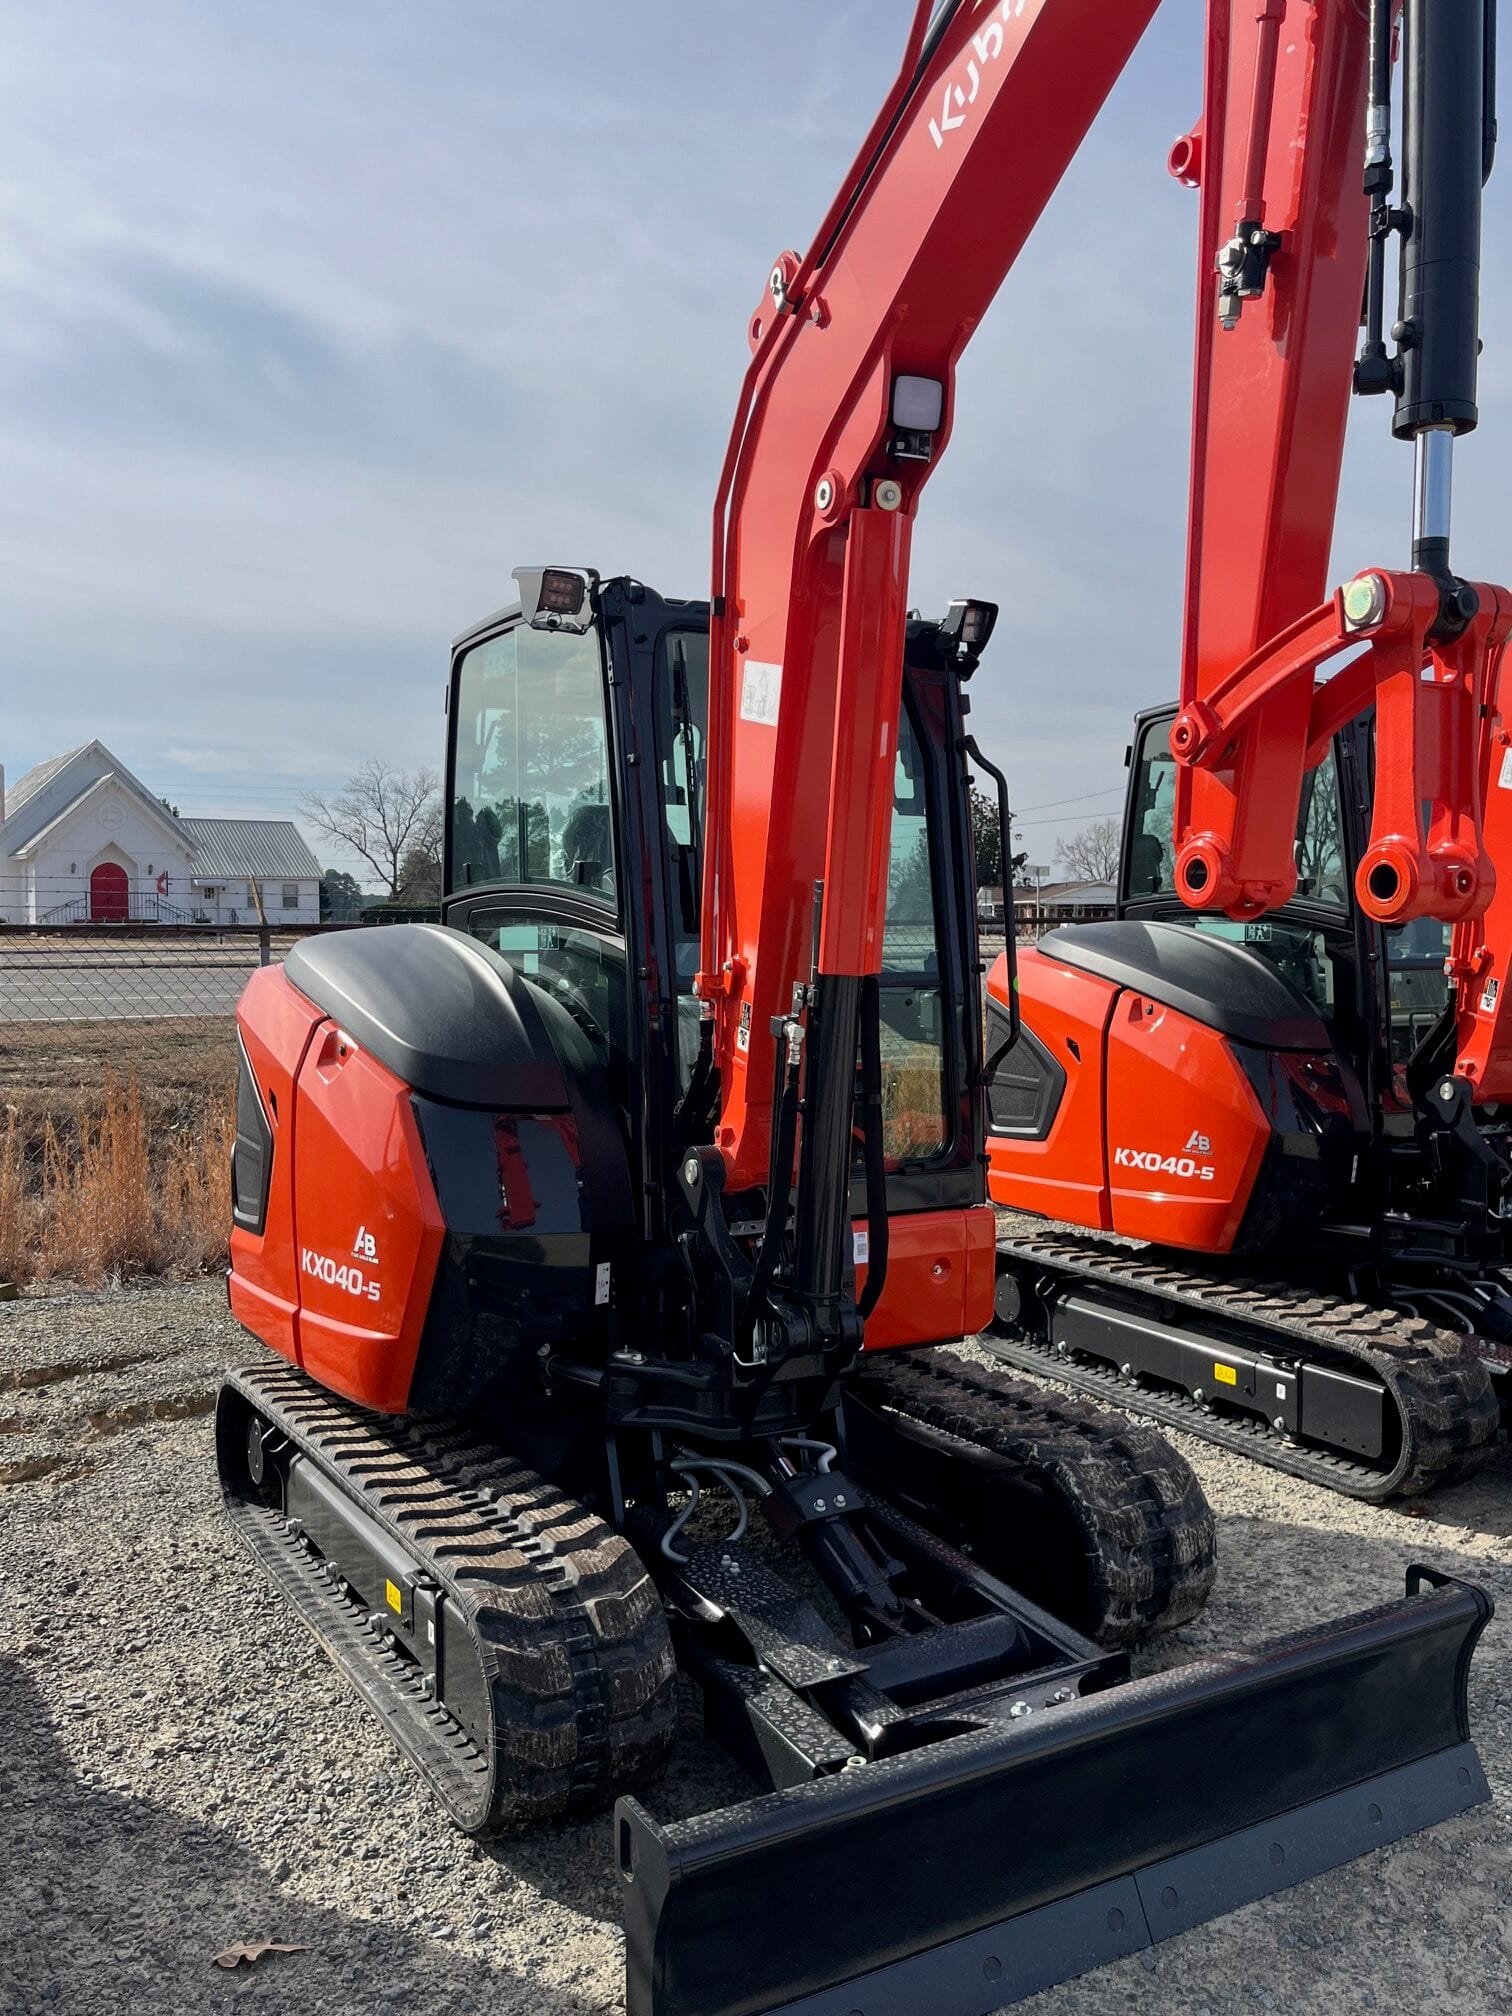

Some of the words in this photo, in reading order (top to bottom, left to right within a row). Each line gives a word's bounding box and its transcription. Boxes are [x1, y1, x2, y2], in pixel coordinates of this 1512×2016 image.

[1185, 1130, 1211, 1151] AB
[1114, 1147, 1215, 1180] KX040-5
[353, 1225, 377, 1257] AB
[301, 1247, 382, 1302] KX040-5
